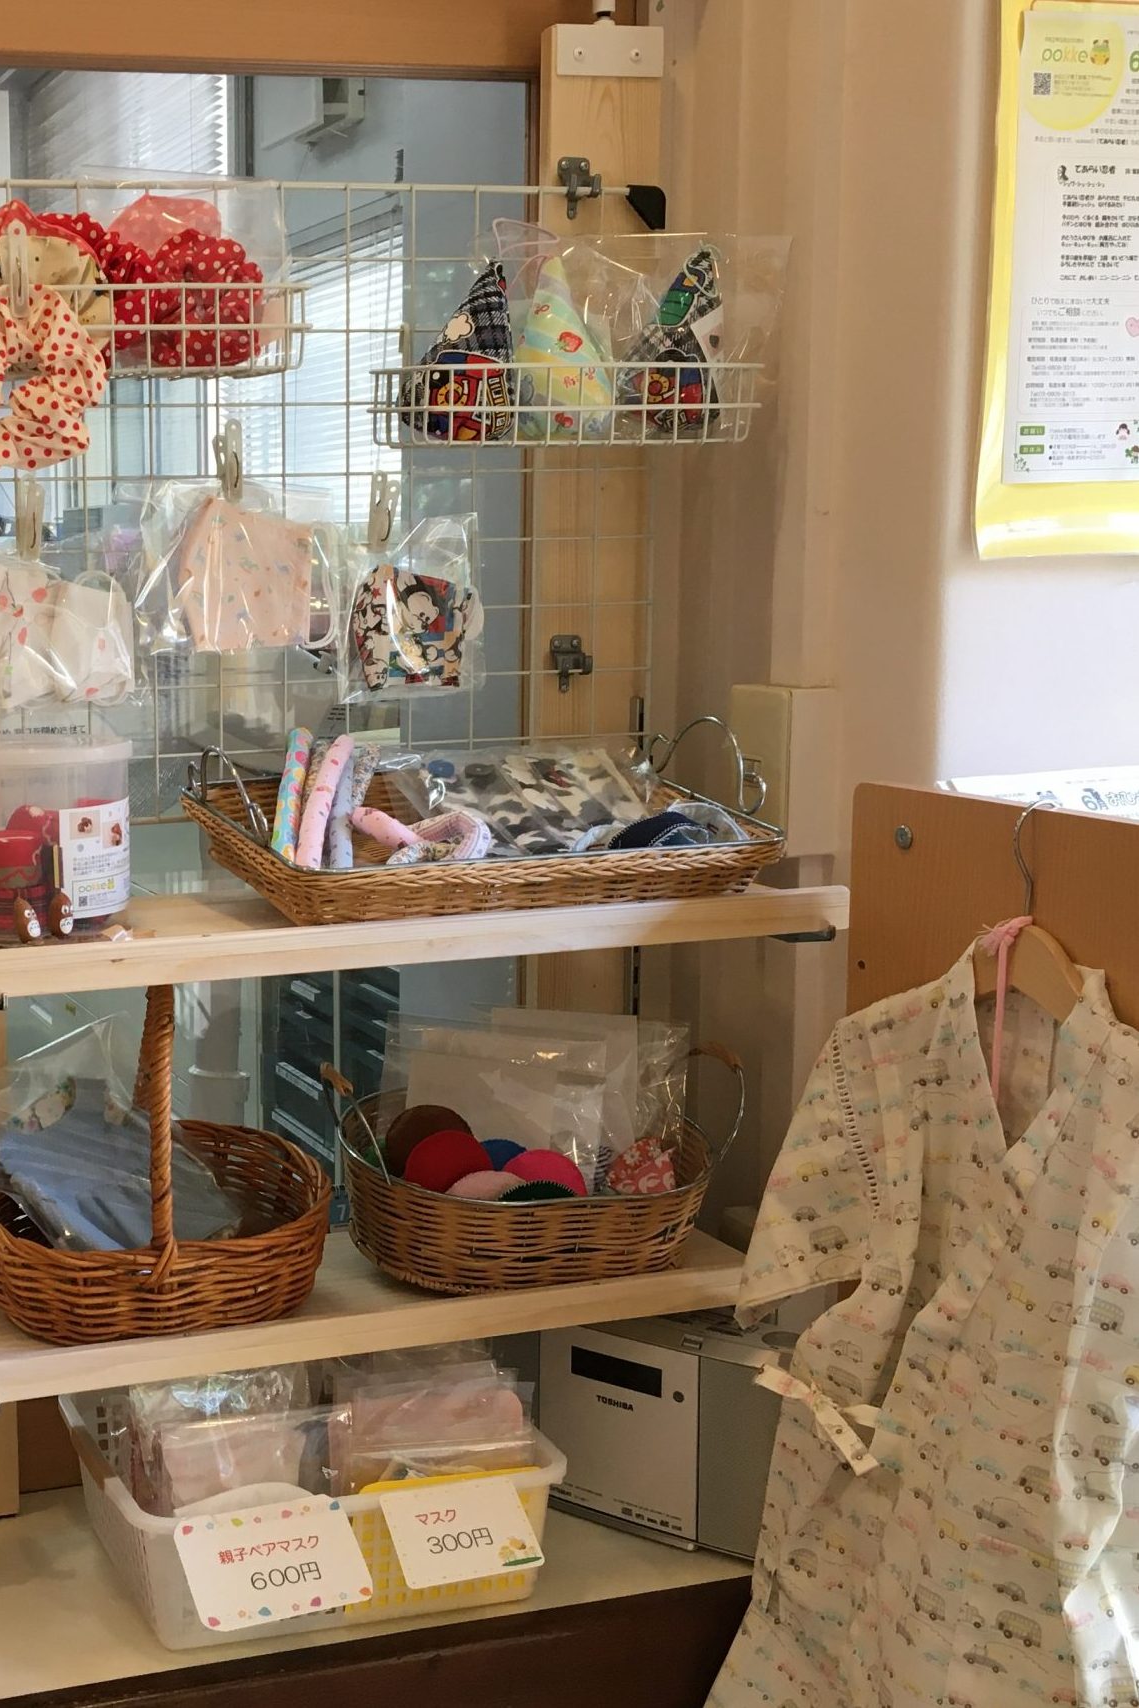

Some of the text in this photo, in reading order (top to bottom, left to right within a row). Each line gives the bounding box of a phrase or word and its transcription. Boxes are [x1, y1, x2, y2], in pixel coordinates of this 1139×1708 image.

[336, 1204, 347, 1221] 7
[596, 1395, 634, 1412] TOSHIBA
[415, 1509, 457, 1526] マスク
[217, 1535, 320, 1565] 親子ペアマスク
[427, 1527, 494, 1555] 300円
[250, 1562, 322, 1591] 600円
